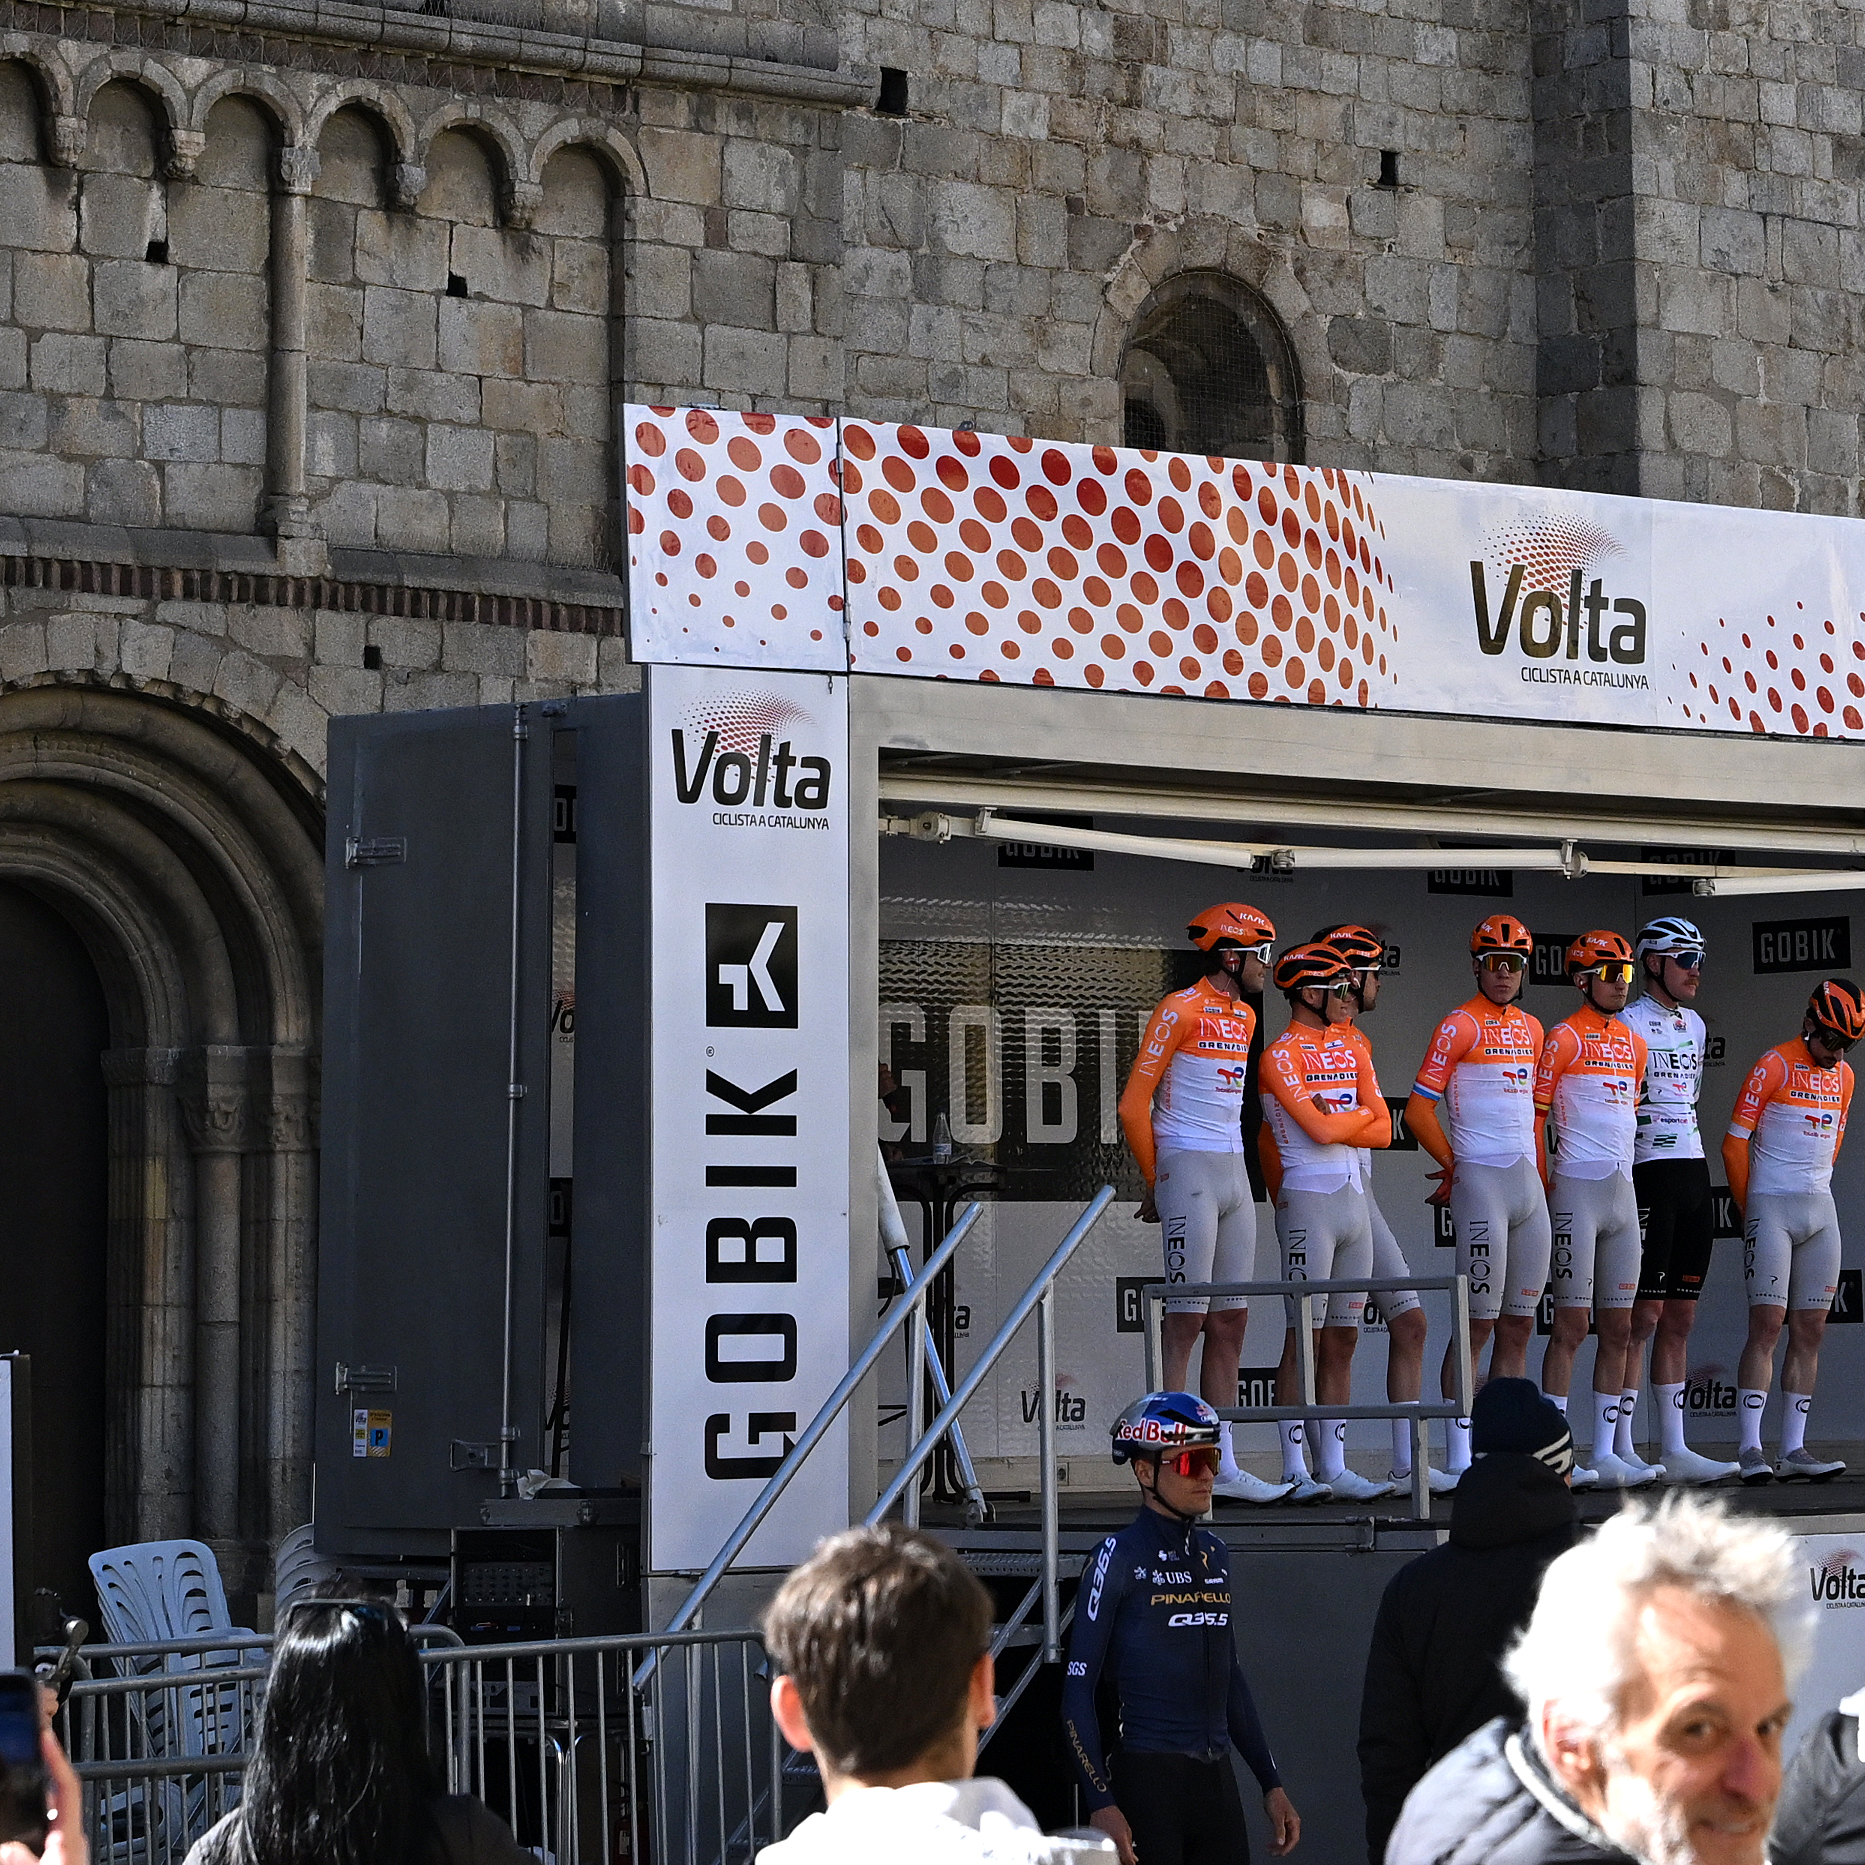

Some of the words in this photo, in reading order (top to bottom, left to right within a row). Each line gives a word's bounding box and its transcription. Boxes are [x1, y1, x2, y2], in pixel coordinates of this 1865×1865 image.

[1470, 561, 1646, 664] Volta
[1521, 667, 1571, 684] CICLISTA
[1573, 671, 1582, 685] A
[1583, 670, 1649, 690] CATALUNYA
[671, 729, 831, 809] Volta
[713, 813, 756, 826] CICLISTA
[758, 815, 766, 827] A
[768, 815, 829, 830] CATALUNYA
[1220, 924, 1244, 935] INEOS
[1240, 913, 1265, 925] KASK
[1761, 929, 1836, 963] GOBIK
[1139, 1008, 1179, 1077] INEOS
[1199, 1018, 1247, 1041] INEOS
[1484, 1028, 1530, 1045] INEOS
[1301, 1050, 1357, 1070] INEOS
[1425, 1023, 1457, 1083] INEOS
[1535, 1040, 1558, 1096] INEOS
[1584, 1042, 1632, 1060] INEOS
[1653, 1052, 1697, 1070] INEOS
[879, 1002, 1148, 1144] GOBI
[1272, 1049, 1311, 1103] INEOS
[1792, 1072, 1839, 1092] INEOS
[1741, 1066, 1766, 1123] INEOS
[1168, 1216, 1186, 1284] INEOS
[1470, 1221, 1490, 1294] INEOS
[1555, 1212, 1573, 1280] INEOS
[1744, 1218, 1760, 1280] INEOS
[704, 1068, 798, 1480] GOBIK
[1021, 1390, 1086, 1424] Vlta
[1687, 1380, 1737, 1410] olta
[1115, 1418, 1146, 1441] Red
[1087, 1536, 1117, 1622] Q36.5
[1165, 1571, 1192, 1584] UBS
[1150, 1592, 1231, 1606] PINARELLO
[1067, 1661, 1088, 1677] SGS
[1066, 1719, 1106, 1793] PINARELLO
